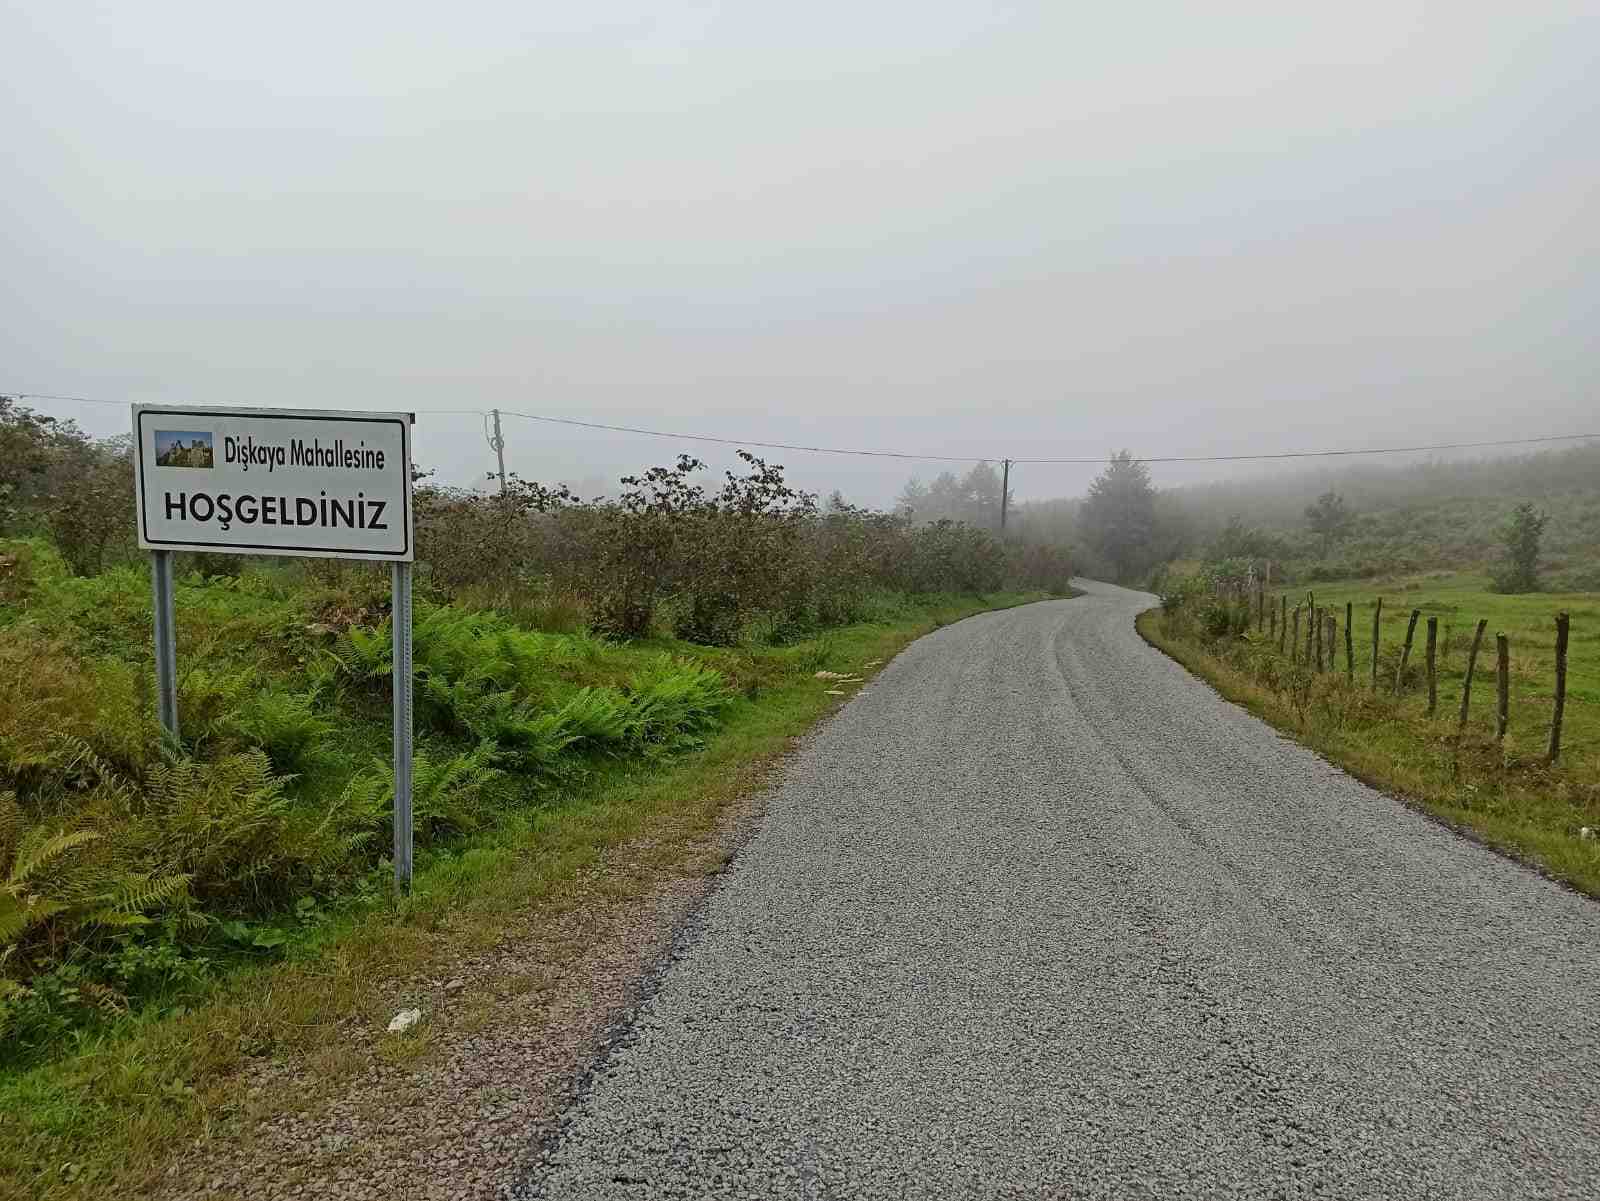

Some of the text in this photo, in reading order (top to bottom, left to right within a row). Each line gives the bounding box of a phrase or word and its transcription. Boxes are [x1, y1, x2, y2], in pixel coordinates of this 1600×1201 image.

[224, 436, 385, 472] Dişkaya Mahallesine
[165, 490, 388, 531] HOŞGELDİNİZ
